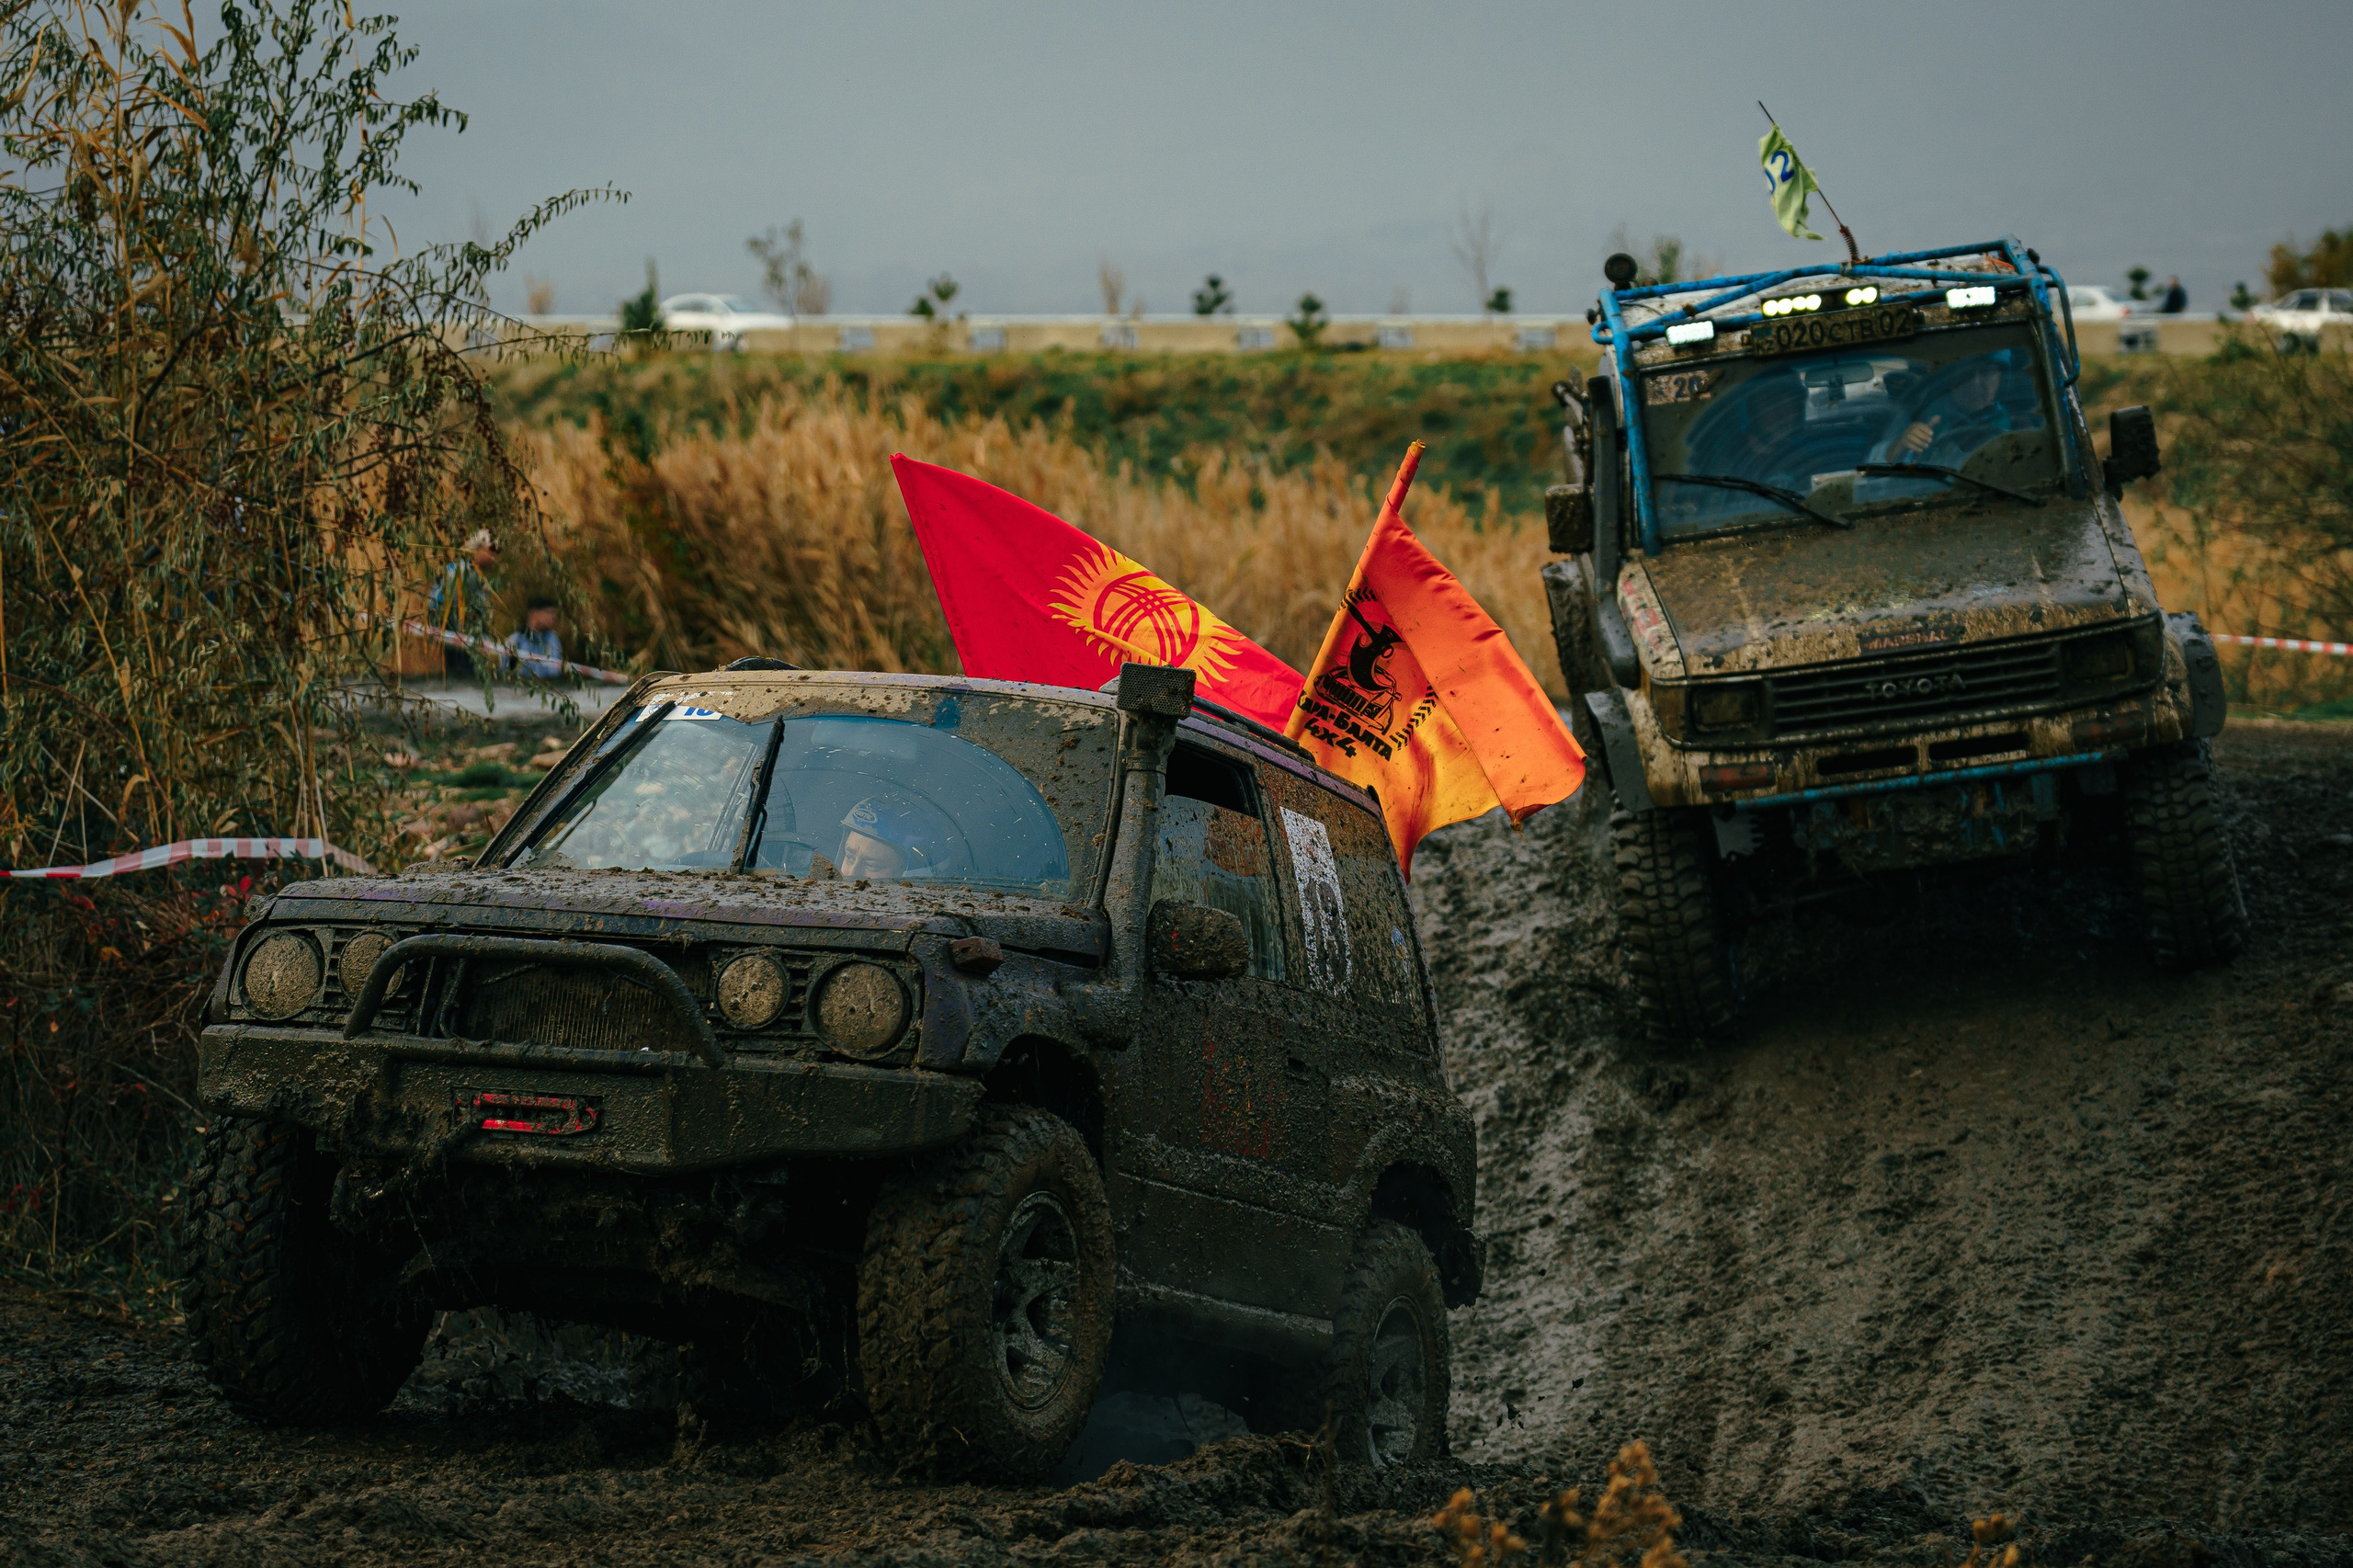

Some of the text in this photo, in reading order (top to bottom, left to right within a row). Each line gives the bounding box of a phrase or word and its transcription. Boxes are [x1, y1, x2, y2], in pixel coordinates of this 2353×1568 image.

[1776, 321, 1824, 348] 020
[1880, 309, 1911, 335] 02
[1865, 673, 1966, 700] TOYOTA
